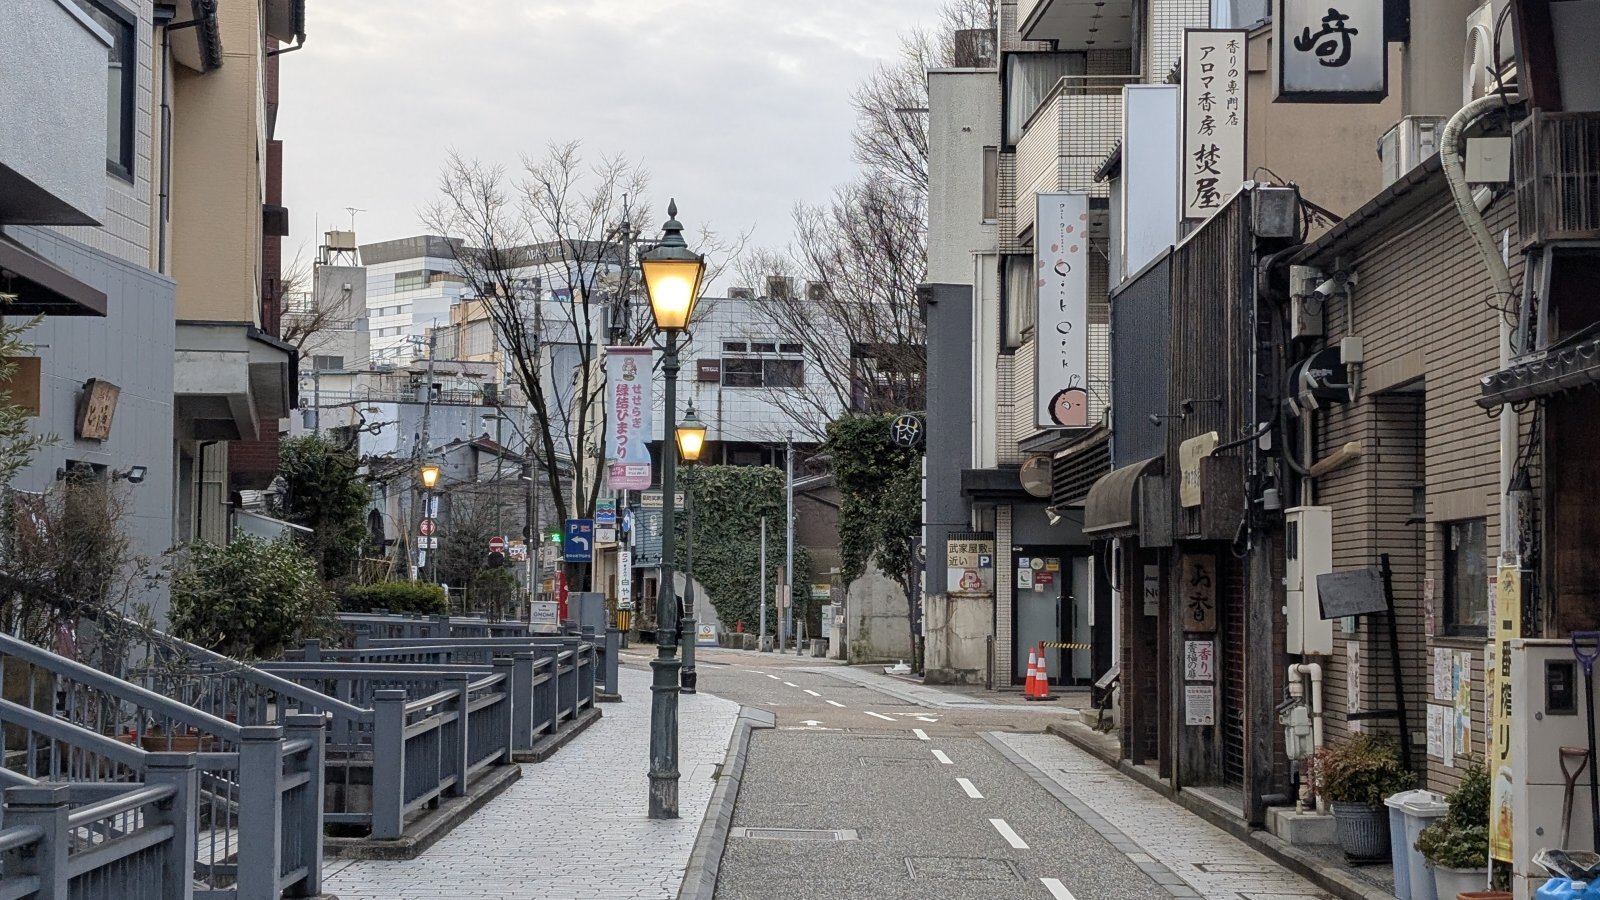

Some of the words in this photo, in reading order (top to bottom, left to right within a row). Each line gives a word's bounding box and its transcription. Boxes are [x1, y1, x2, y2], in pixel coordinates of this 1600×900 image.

[1197, 46, 1218, 137] アロマ香房
[1225, 39, 1240, 126] 香りの専門店
[1190, 143, 1222, 209] 焚屋
[1054, 261, 1071, 312] Oink
[1056, 321, 1072, 369] Oink
[616, 383, 629, 459] 縁結びまつり
[632, 383, 642, 429] せせらぎ
[571, 524, 578, 534] P
[948, 543, 992, 554] 武家屋敷に
[948, 555, 968, 567] 近い
[980, 556, 990, 567] P
[1198, 647, 1211, 674] 香り
[1500, 619, 1513, 761] 一番搾り
